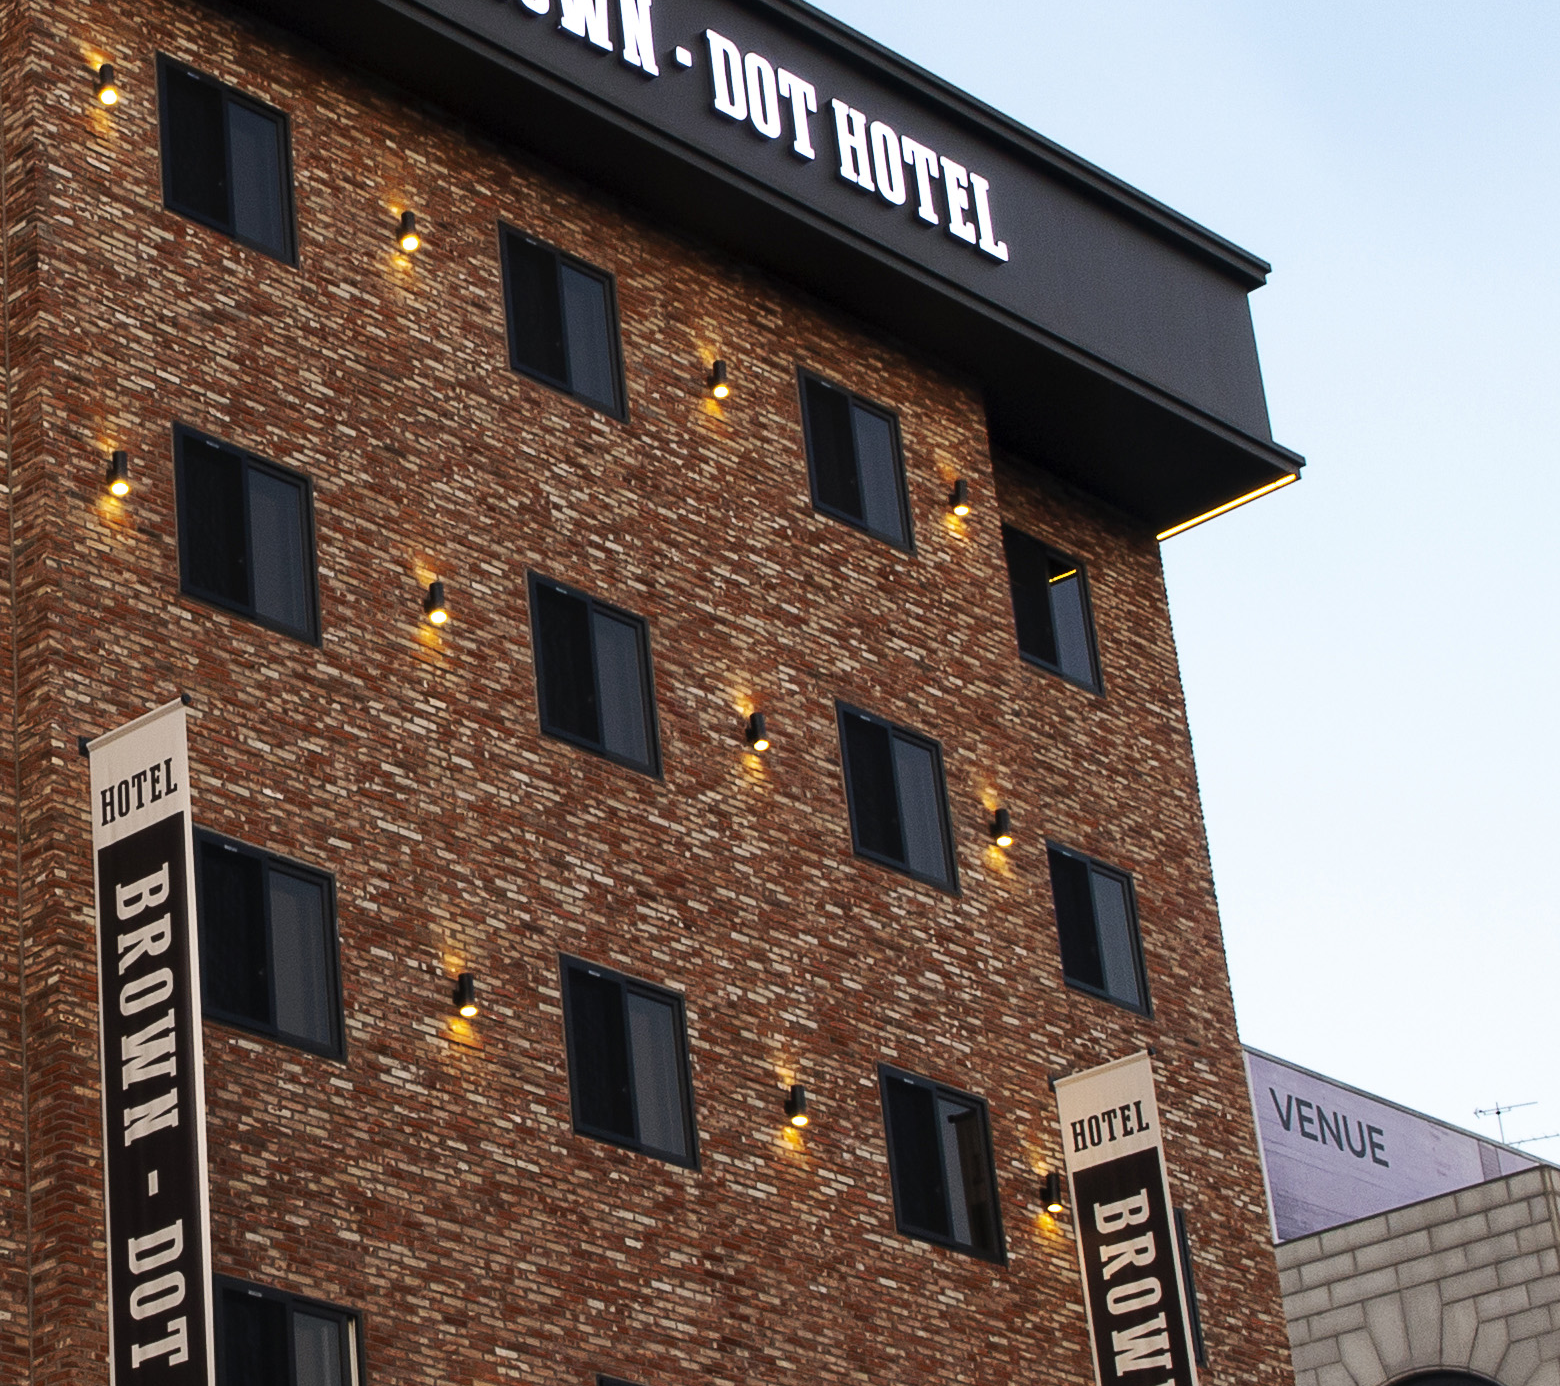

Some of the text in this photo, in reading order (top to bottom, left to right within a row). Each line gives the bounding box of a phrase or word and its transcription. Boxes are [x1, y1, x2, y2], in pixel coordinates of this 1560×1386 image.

[705, 28, 818, 160] DOT
[831, 97, 1009, 263] HOTEL
[99, 756, 179, 828] HOTEL
[115, 861, 179, 1148] BROWN
[1071, 1100, 1150, 1153] HOTEL
[1268, 1087, 1391, 1169] VENUE
[127, 1218, 189, 1370] DOT
